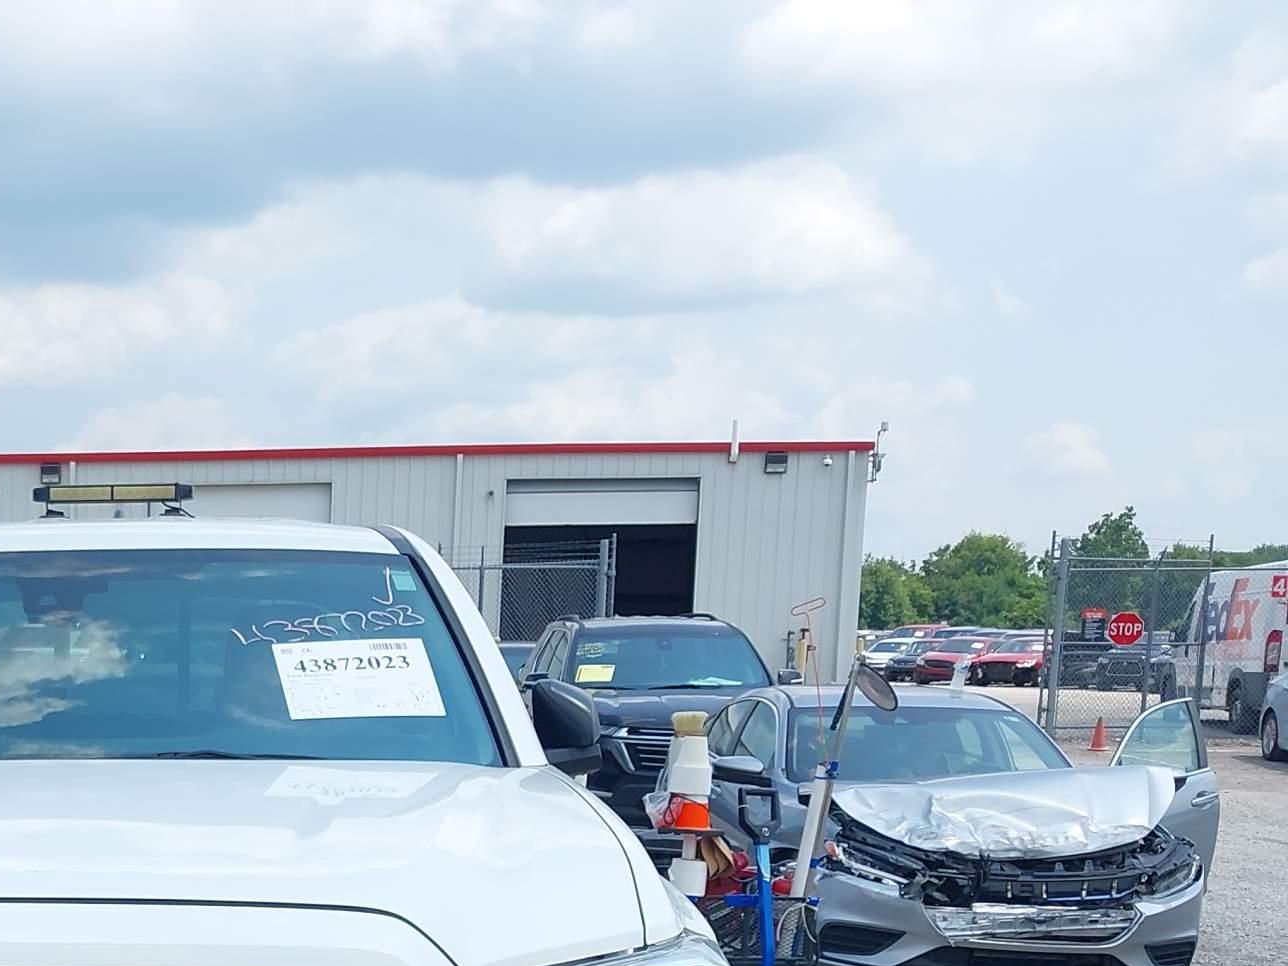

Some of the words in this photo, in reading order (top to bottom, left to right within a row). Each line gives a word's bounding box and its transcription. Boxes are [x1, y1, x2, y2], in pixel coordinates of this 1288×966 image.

[1274, 578, 1286, 595] 4
[1110, 622, 1142, 636] STOP
[294, 655, 410, 673] 43872023
